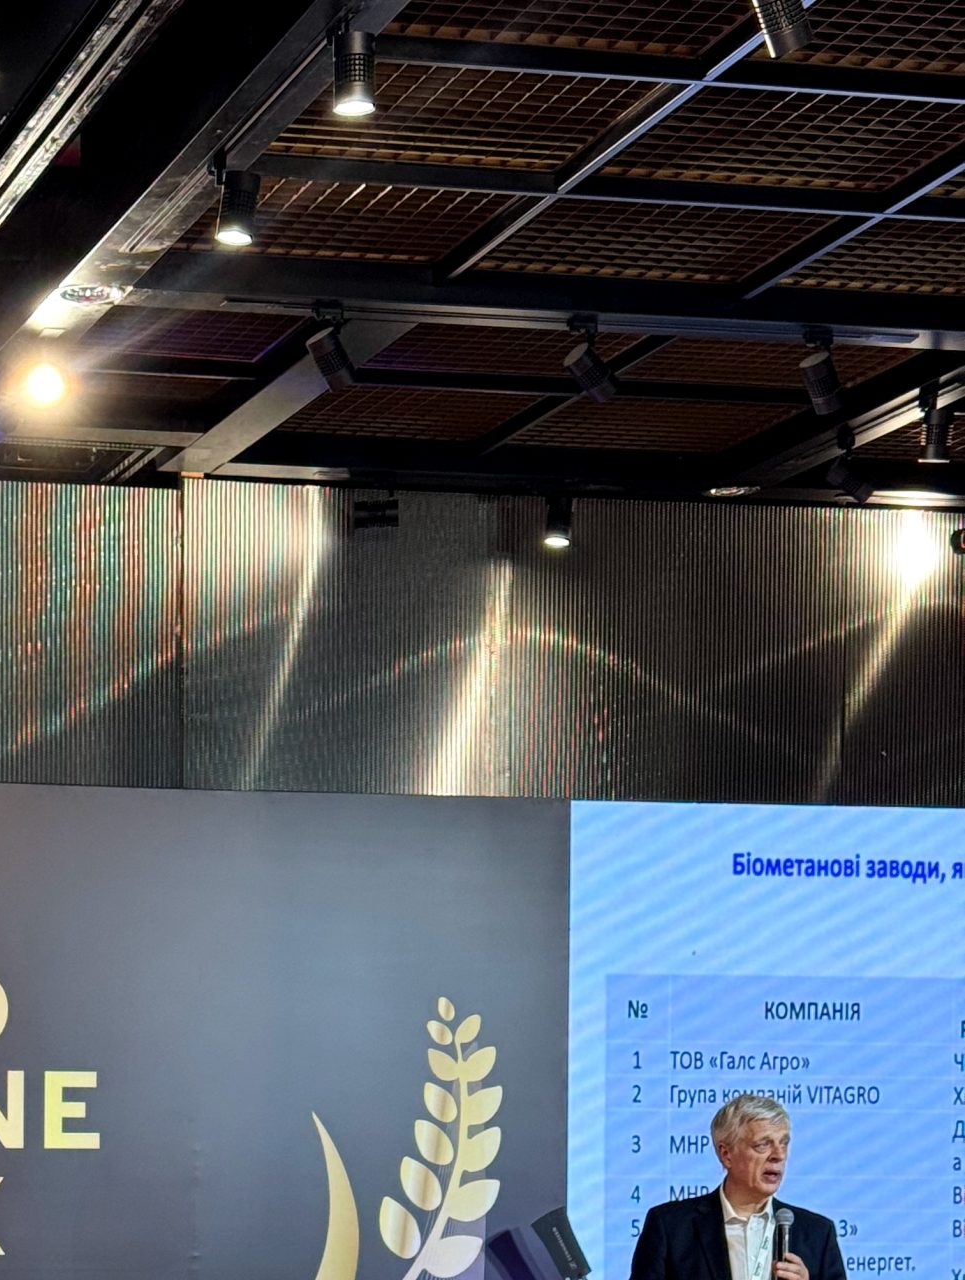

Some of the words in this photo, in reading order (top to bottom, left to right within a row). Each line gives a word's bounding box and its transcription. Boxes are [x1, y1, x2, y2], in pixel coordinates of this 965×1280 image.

[732, 851, 861, 877] Біометанові
[866, 858, 947, 884] заводи,
[627, 1000, 649, 1019] №
[764, 1001, 861, 1021] КОМПАНІЯ
[632, 1051, 642, 1070] 1
[670, 1051, 704, 1070] ТОВ
[709, 1051, 756, 1070] «Галс
[759, 1051, 811, 1075] Агро»
[632, 1084, 642, 1104] 2
[670, 1085, 717, 1108] Група
[807, 1086, 880, 1105] VITAGRO
[631, 1135, 642, 1154] 3
[630, 1185, 641, 1204] 4
[631, 1219, 640, 1238] 5
[846, 1256, 916, 1277] енергет.
